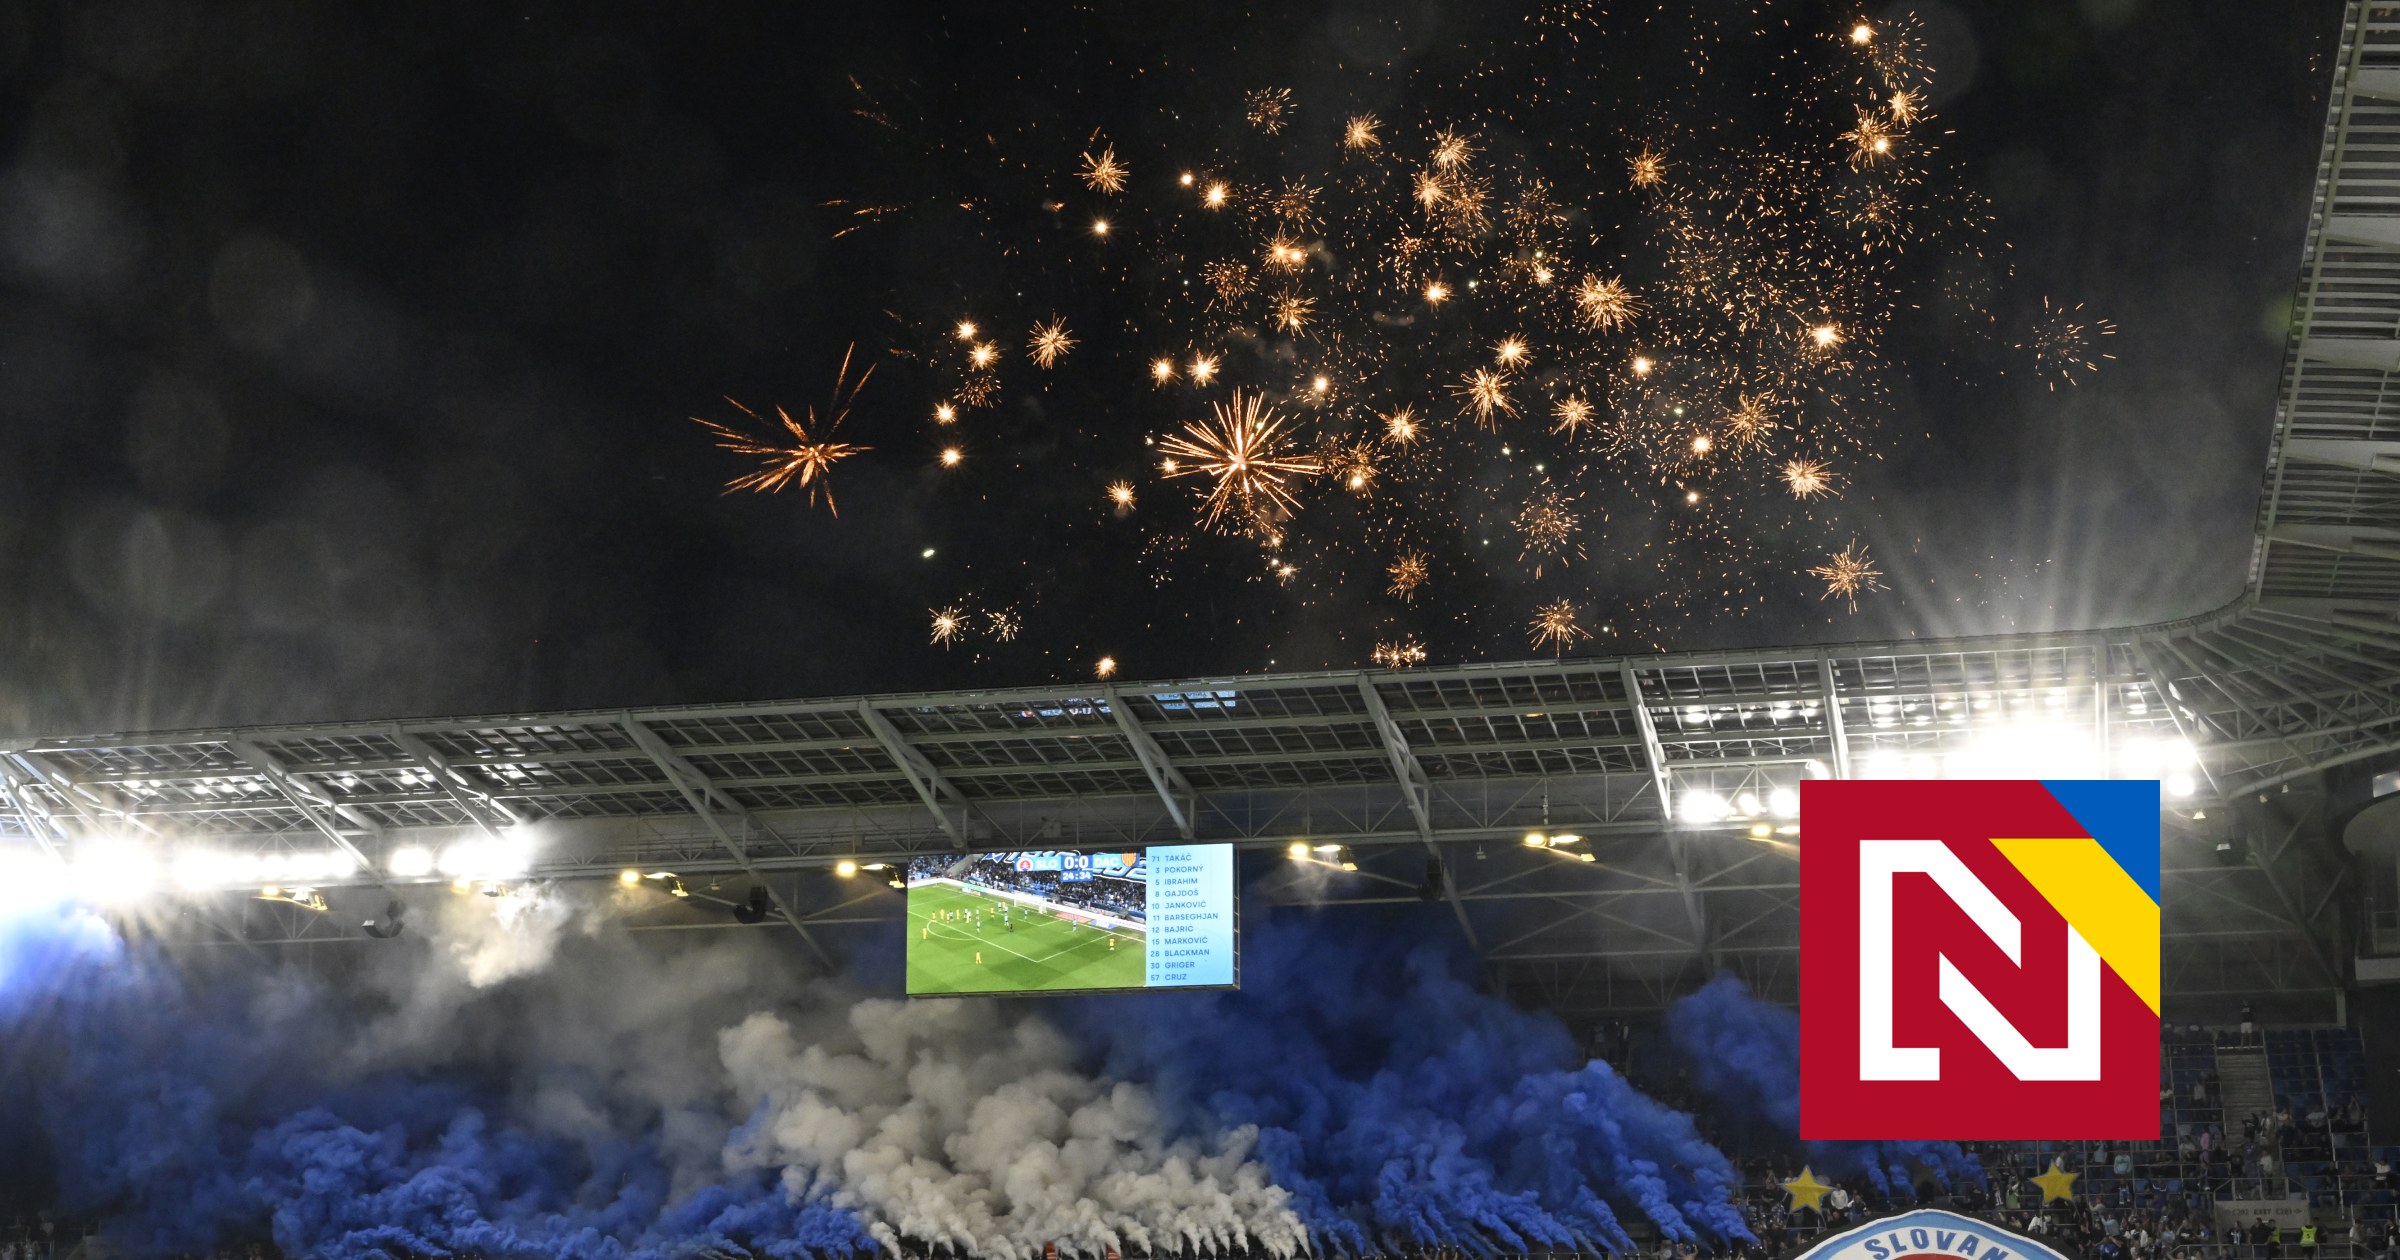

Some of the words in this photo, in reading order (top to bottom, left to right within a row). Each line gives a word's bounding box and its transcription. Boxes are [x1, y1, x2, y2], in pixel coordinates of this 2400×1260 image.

[1164, 853, 1192, 861] TAKÁČ
[1036, 860, 1058, 869] SLO
[1064, 856, 1089, 869] 0:0
[1094, 857, 1119, 867] DAC
[1164, 864, 1204, 873] POKORNÝ
[1062, 872, 1091, 880] 24:34
[1164, 888, 1199, 897] GAJDOŠ
[1164, 913, 1219, 921] BARSEGHJAN
[1164, 949, 1210, 957] BLACKMAN
[1164, 961, 1195, 969] GRIGER
[1164, 973, 1187, 981] CRUZ
[1864, 1228, 2009, 1260] SLOVAN
